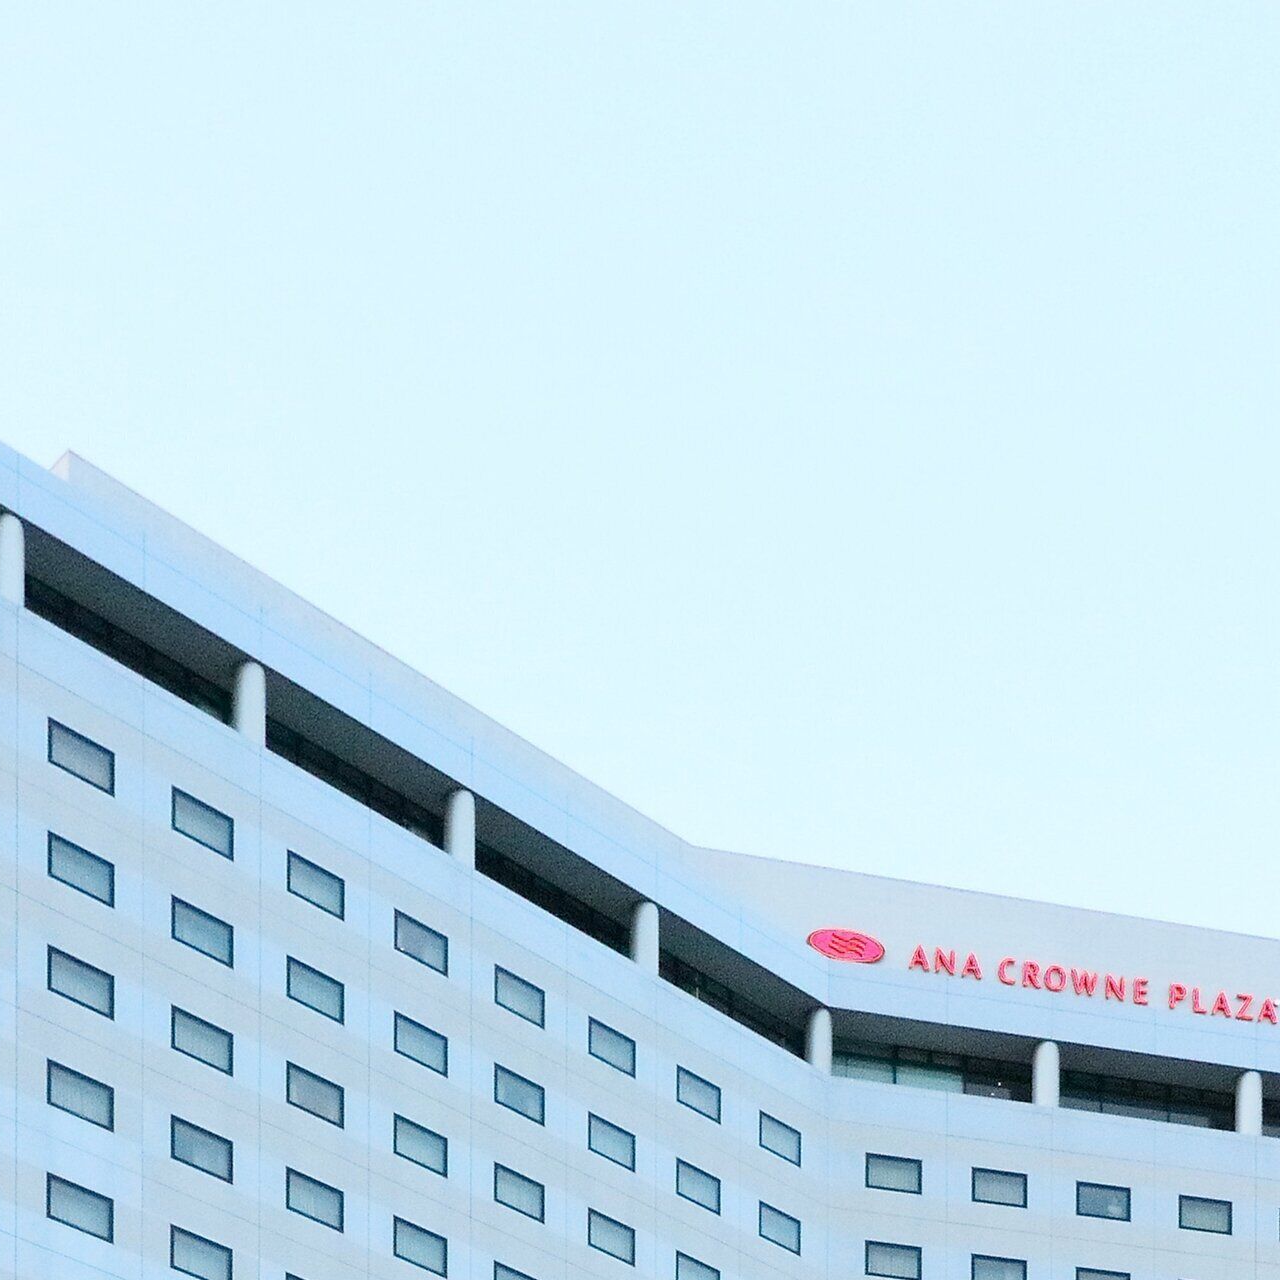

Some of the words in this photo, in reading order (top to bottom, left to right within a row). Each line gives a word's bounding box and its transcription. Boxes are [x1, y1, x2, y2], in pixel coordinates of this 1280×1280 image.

[908, 943, 983, 981] ANA
[997, 956, 1149, 1006] CROWNE
[1168, 982, 1279, 1025] PLAZA
